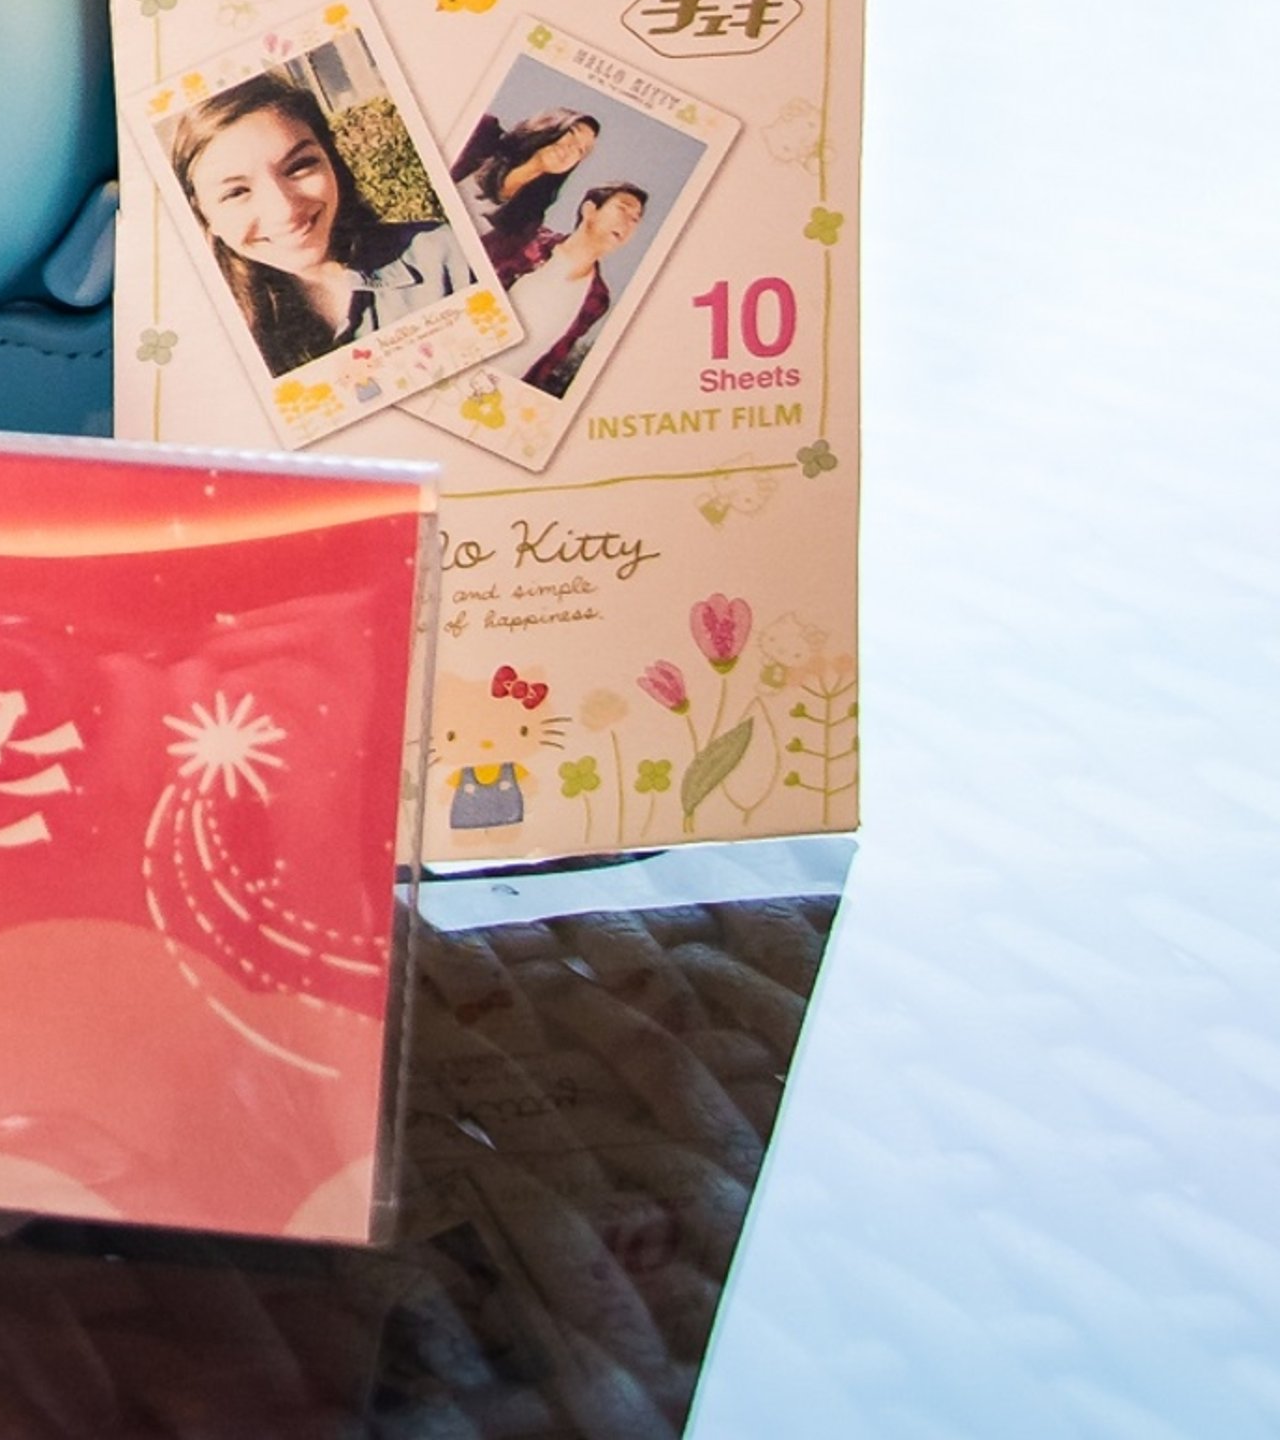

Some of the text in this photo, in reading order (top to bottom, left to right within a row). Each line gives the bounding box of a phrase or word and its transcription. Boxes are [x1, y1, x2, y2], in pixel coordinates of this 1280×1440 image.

[692, 277, 797, 360] 10
[699, 365, 801, 393] Sheets
[588, 403, 803, 440] INSTANT FILM
[511, 520, 661, 580] Kitty
[453, 576, 599, 604] and simple
[443, 610, 470, 638] of
